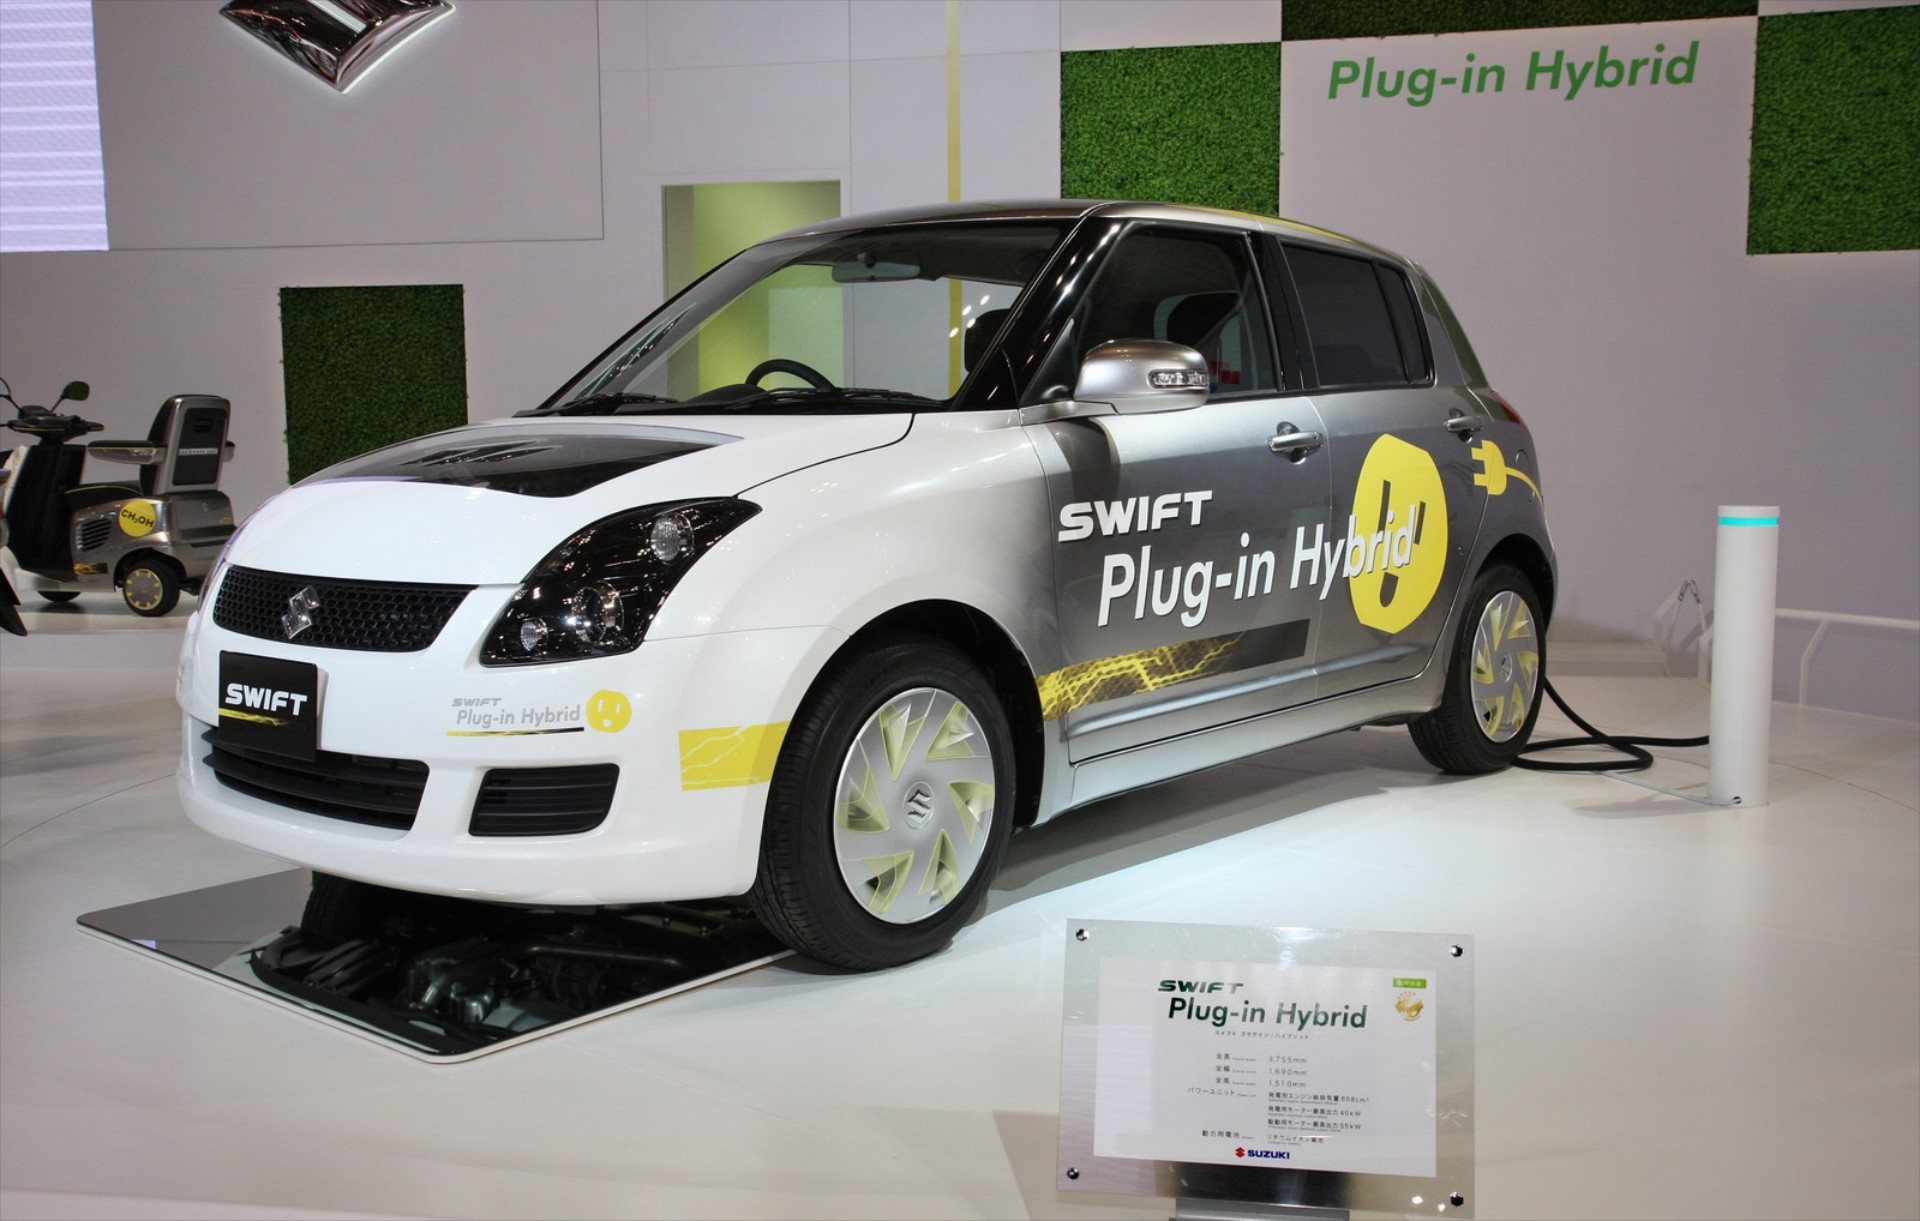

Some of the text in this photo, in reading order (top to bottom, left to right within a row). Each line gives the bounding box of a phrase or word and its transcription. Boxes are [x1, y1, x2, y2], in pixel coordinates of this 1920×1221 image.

[1328, 41, 1700, 107] Plug-in Hybrid
[1058, 490, 1213, 542] SWIFT
[1098, 504, 1417, 628] Plug-in Hybrid
[225, 683, 308, 716] SWIFT
[452, 698, 501, 707] SWIFT
[456, 704, 581, 729] Plug-in Hybrid
[1158, 979, 1244, 994] SWIFT
[1168, 996, 1266, 1027] Plug-in
[1276, 1002, 1367, 1031] Hybrid
[1247, 1149, 1290, 1160] SUZUKI
